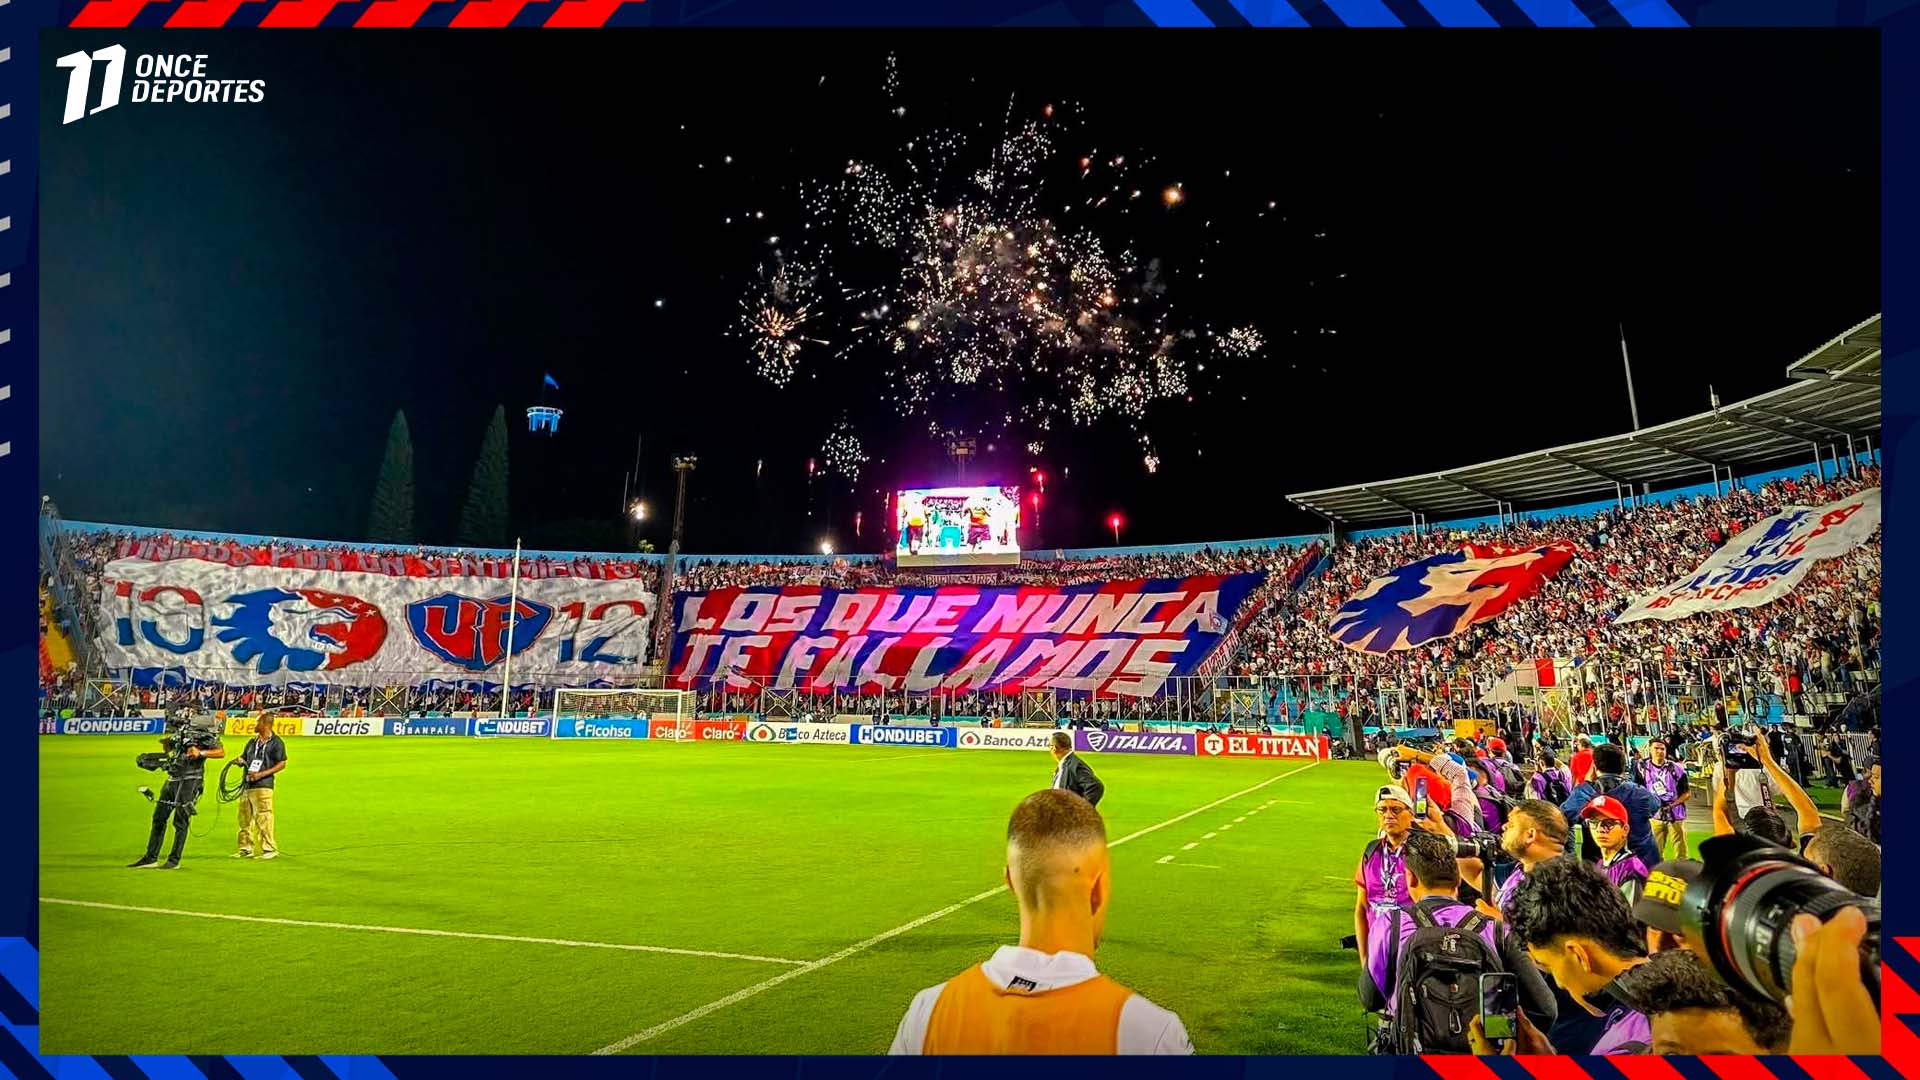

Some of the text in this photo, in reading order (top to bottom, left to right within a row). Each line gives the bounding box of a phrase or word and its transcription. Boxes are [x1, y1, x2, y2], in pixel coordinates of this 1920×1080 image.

[119, 538, 255, 566] UNIDOS
[360, 554, 405, 577] UN
[421, 556, 640, 580] SENTIMIENTO
[104, 578, 205, 655] 10
[678, 590, 1225, 635] LOS QUE NUNCA
[557, 600, 647, 664] 12
[677, 634, 772, 688] TE
[775, 636, 1190, 698] FALLAMOS
[64, 719, 151, 734] HONDUBET
[246, 722, 296, 735] etra
[314, 720, 369, 735] betcris
[478, 719, 546, 735] NDUBET
[585, 726, 631, 738] Ficohsa
[655, 726, 686, 739] Claro
[702, 727, 734, 740] Claro
[779, 728, 847, 741] Bco Azteca
[858, 725, 944, 745] HONDUBET
[983, 735, 1051, 747] Banco Azt
[1229, 737, 1256, 754] EL
[1258, 738, 1320, 756] TITAN
